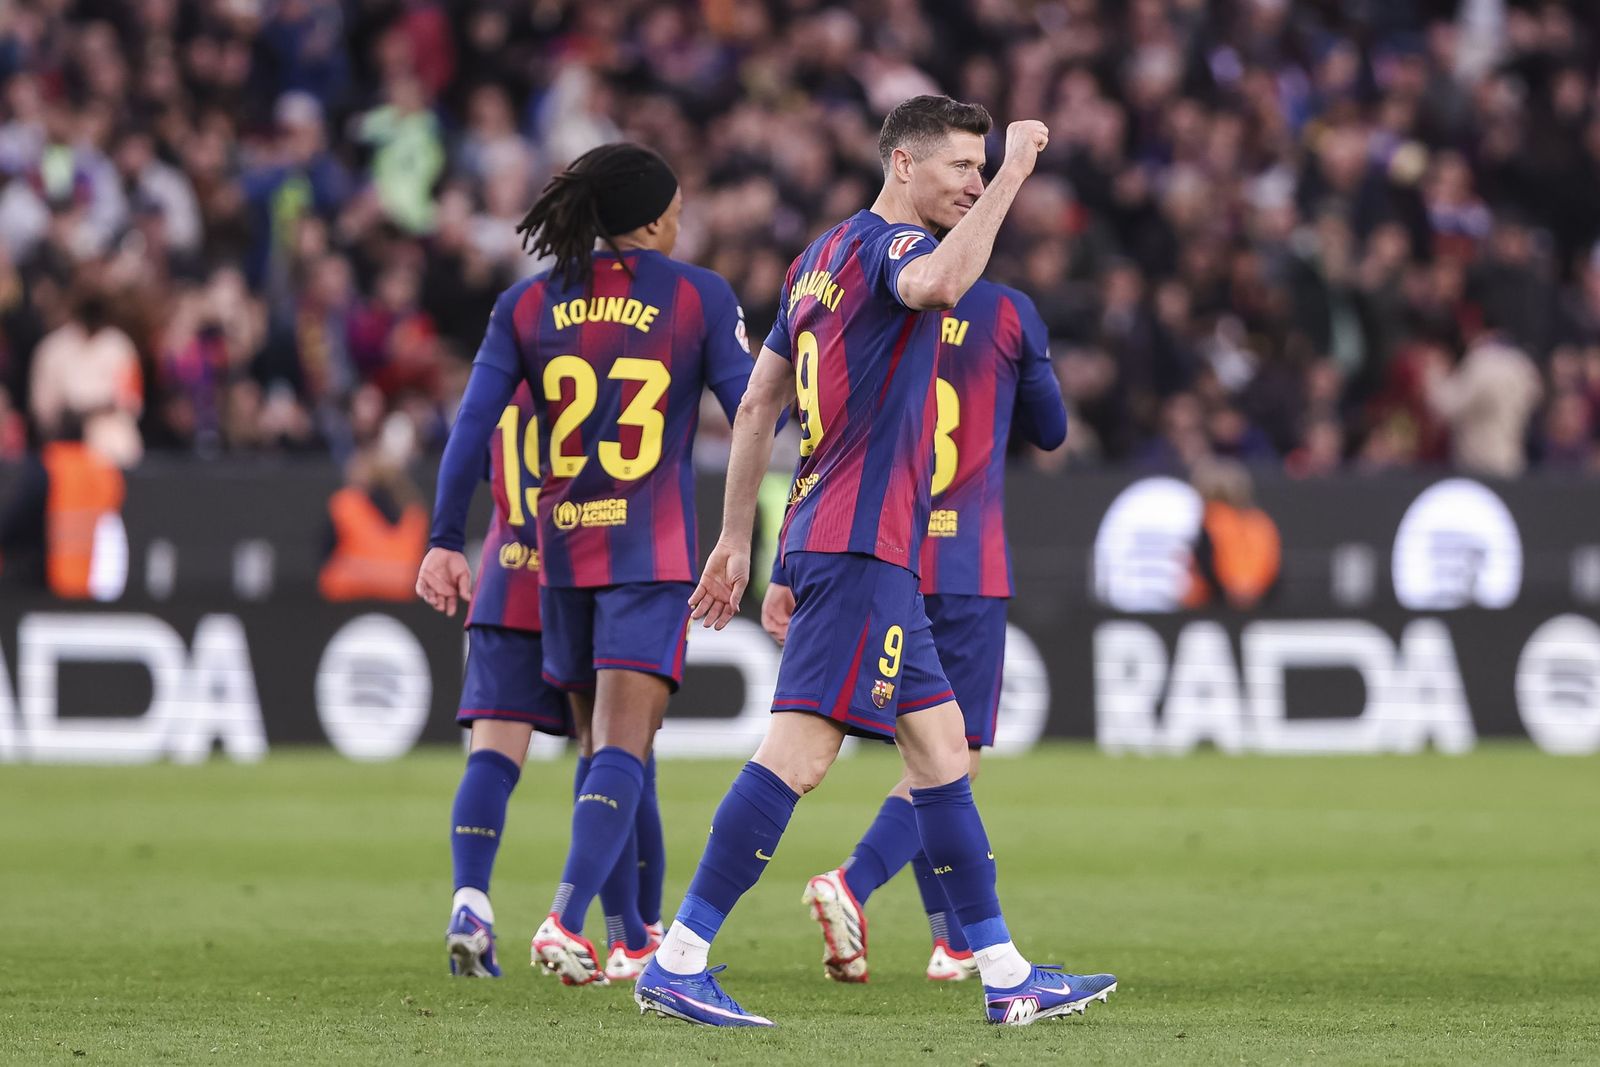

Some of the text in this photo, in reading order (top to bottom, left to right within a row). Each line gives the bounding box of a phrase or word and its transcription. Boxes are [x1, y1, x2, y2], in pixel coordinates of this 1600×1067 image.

[552, 297, 660, 333] KOUNDE
[942, 316, 970, 346] RI
[543, 355, 671, 481] 23
[796, 330, 825, 457] 9
[879, 625, 903, 677] 9
